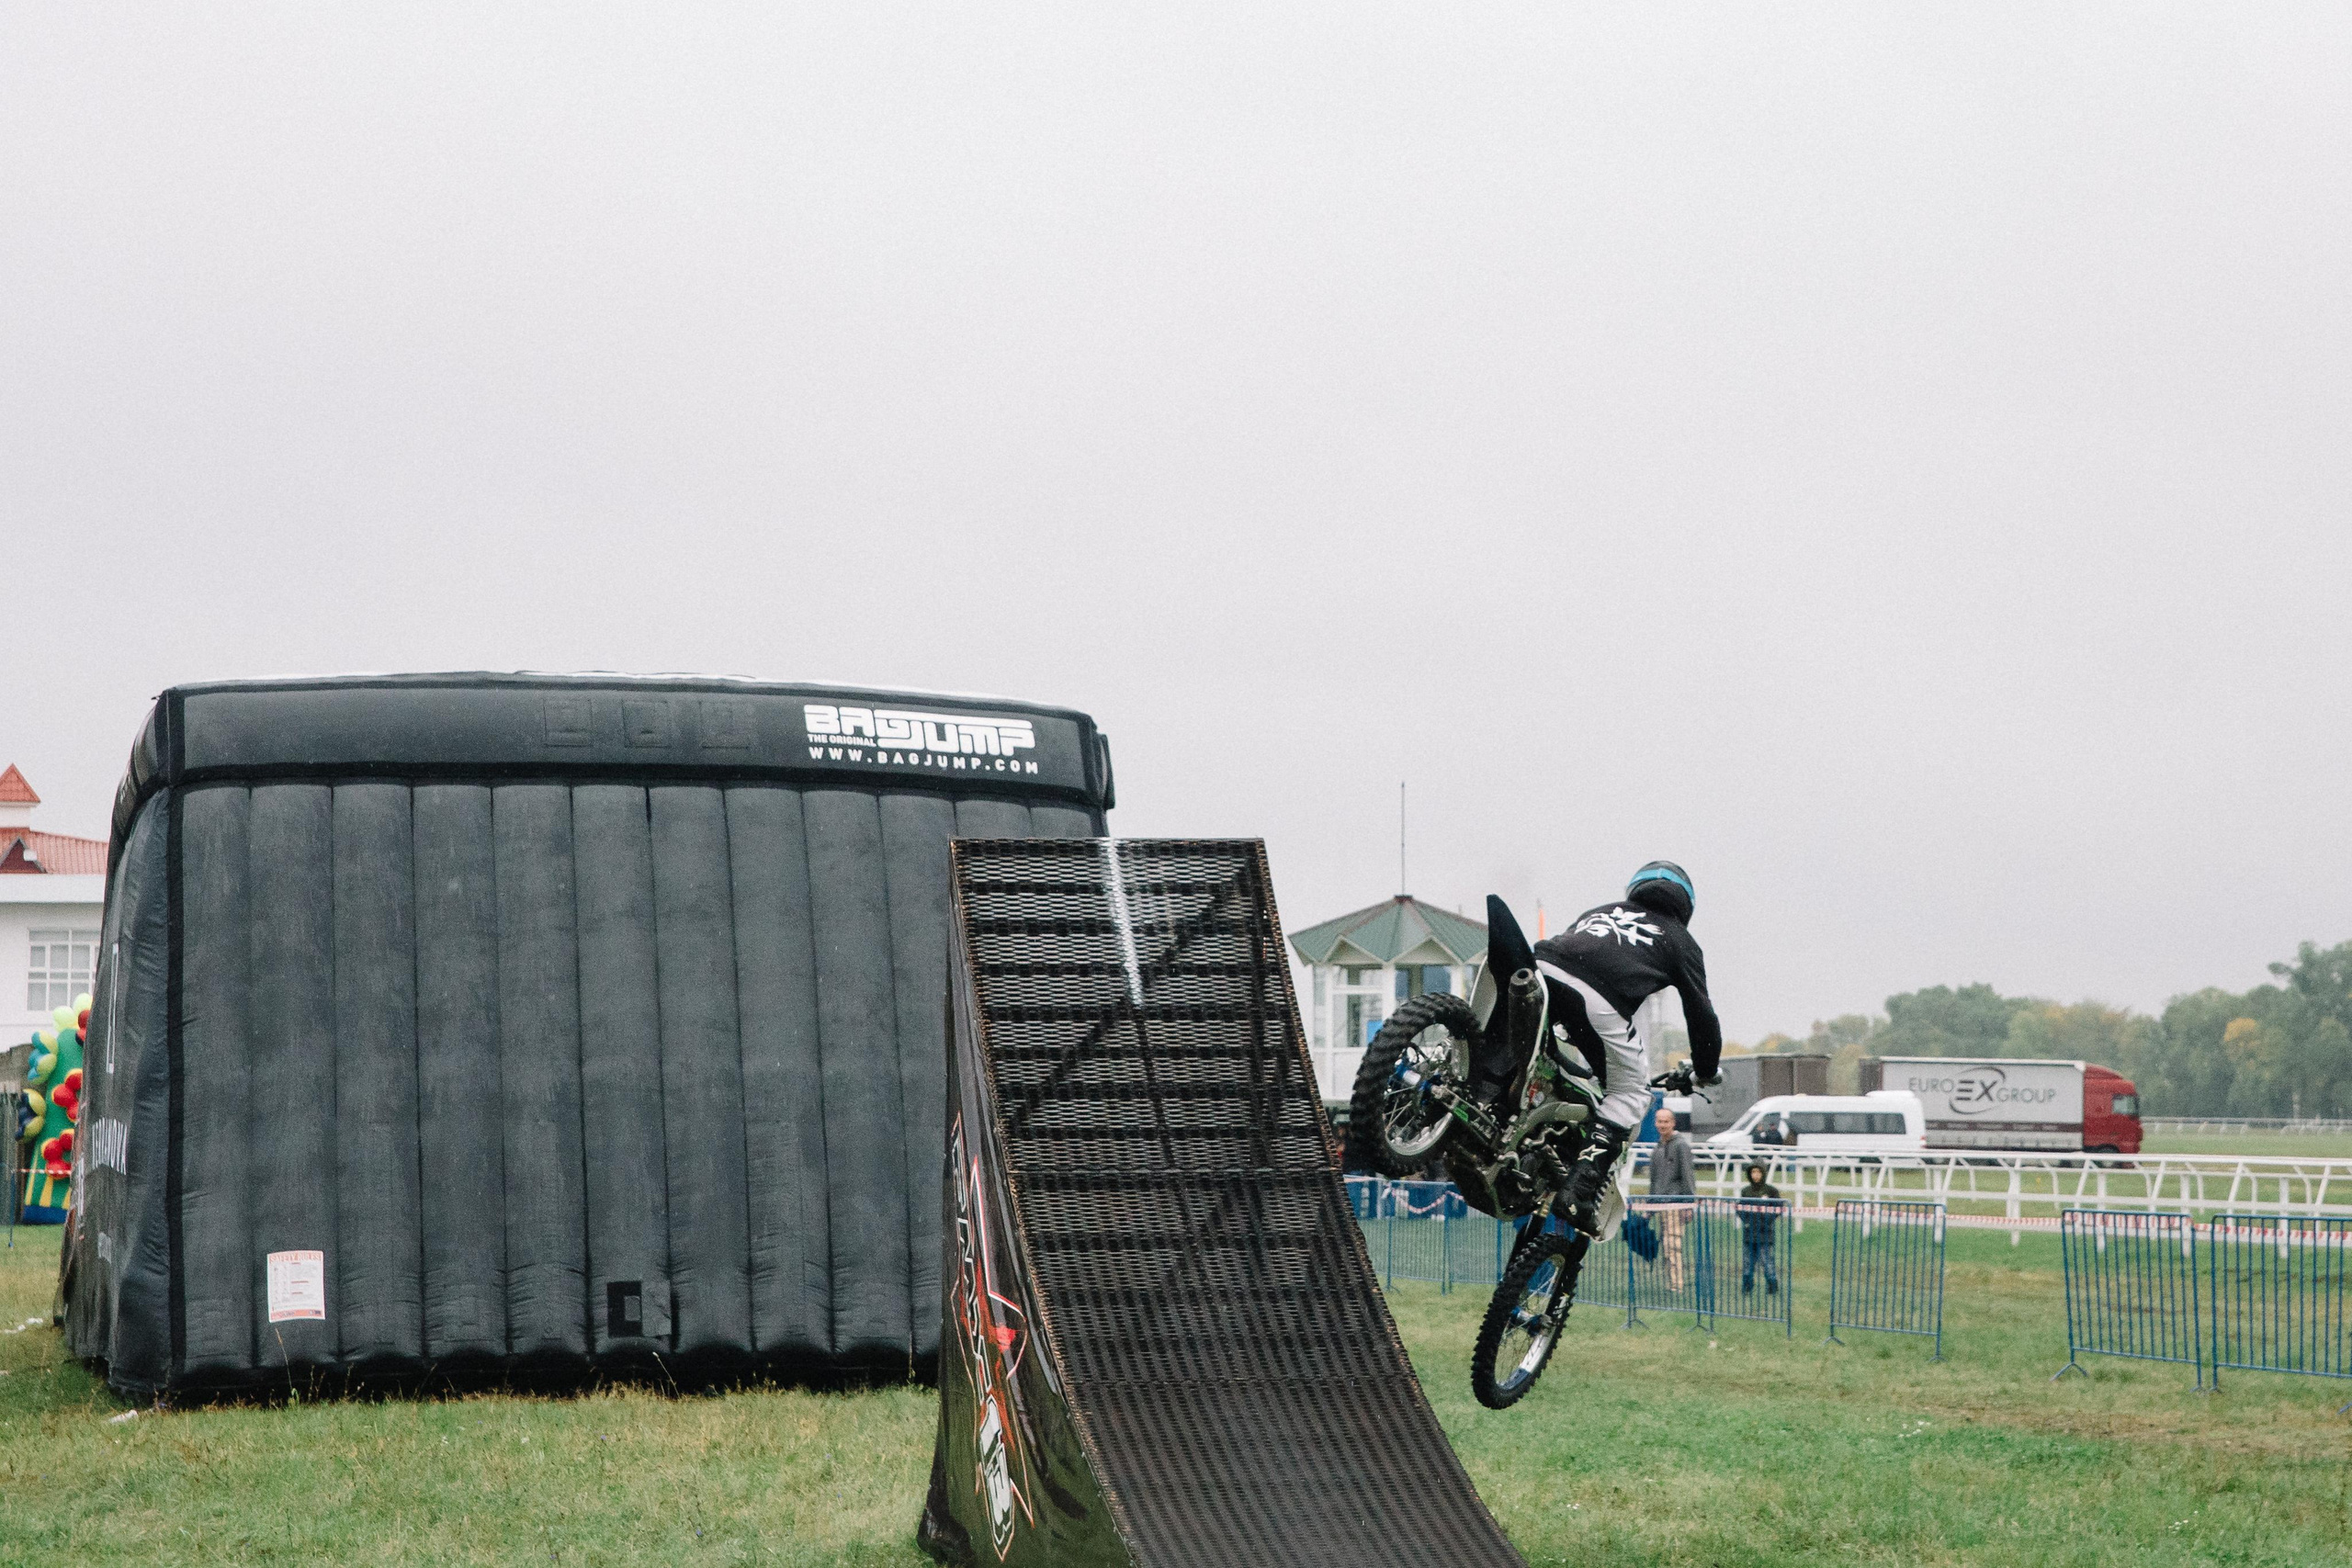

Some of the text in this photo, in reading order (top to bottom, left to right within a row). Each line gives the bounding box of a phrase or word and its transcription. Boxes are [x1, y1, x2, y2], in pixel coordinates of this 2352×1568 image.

[804, 705, 1035, 756] BAGJUMP
[808, 734, 876, 747] THE ORIGINAL
[808, 747, 1038, 774] WWW.BAGJUMP.COM
